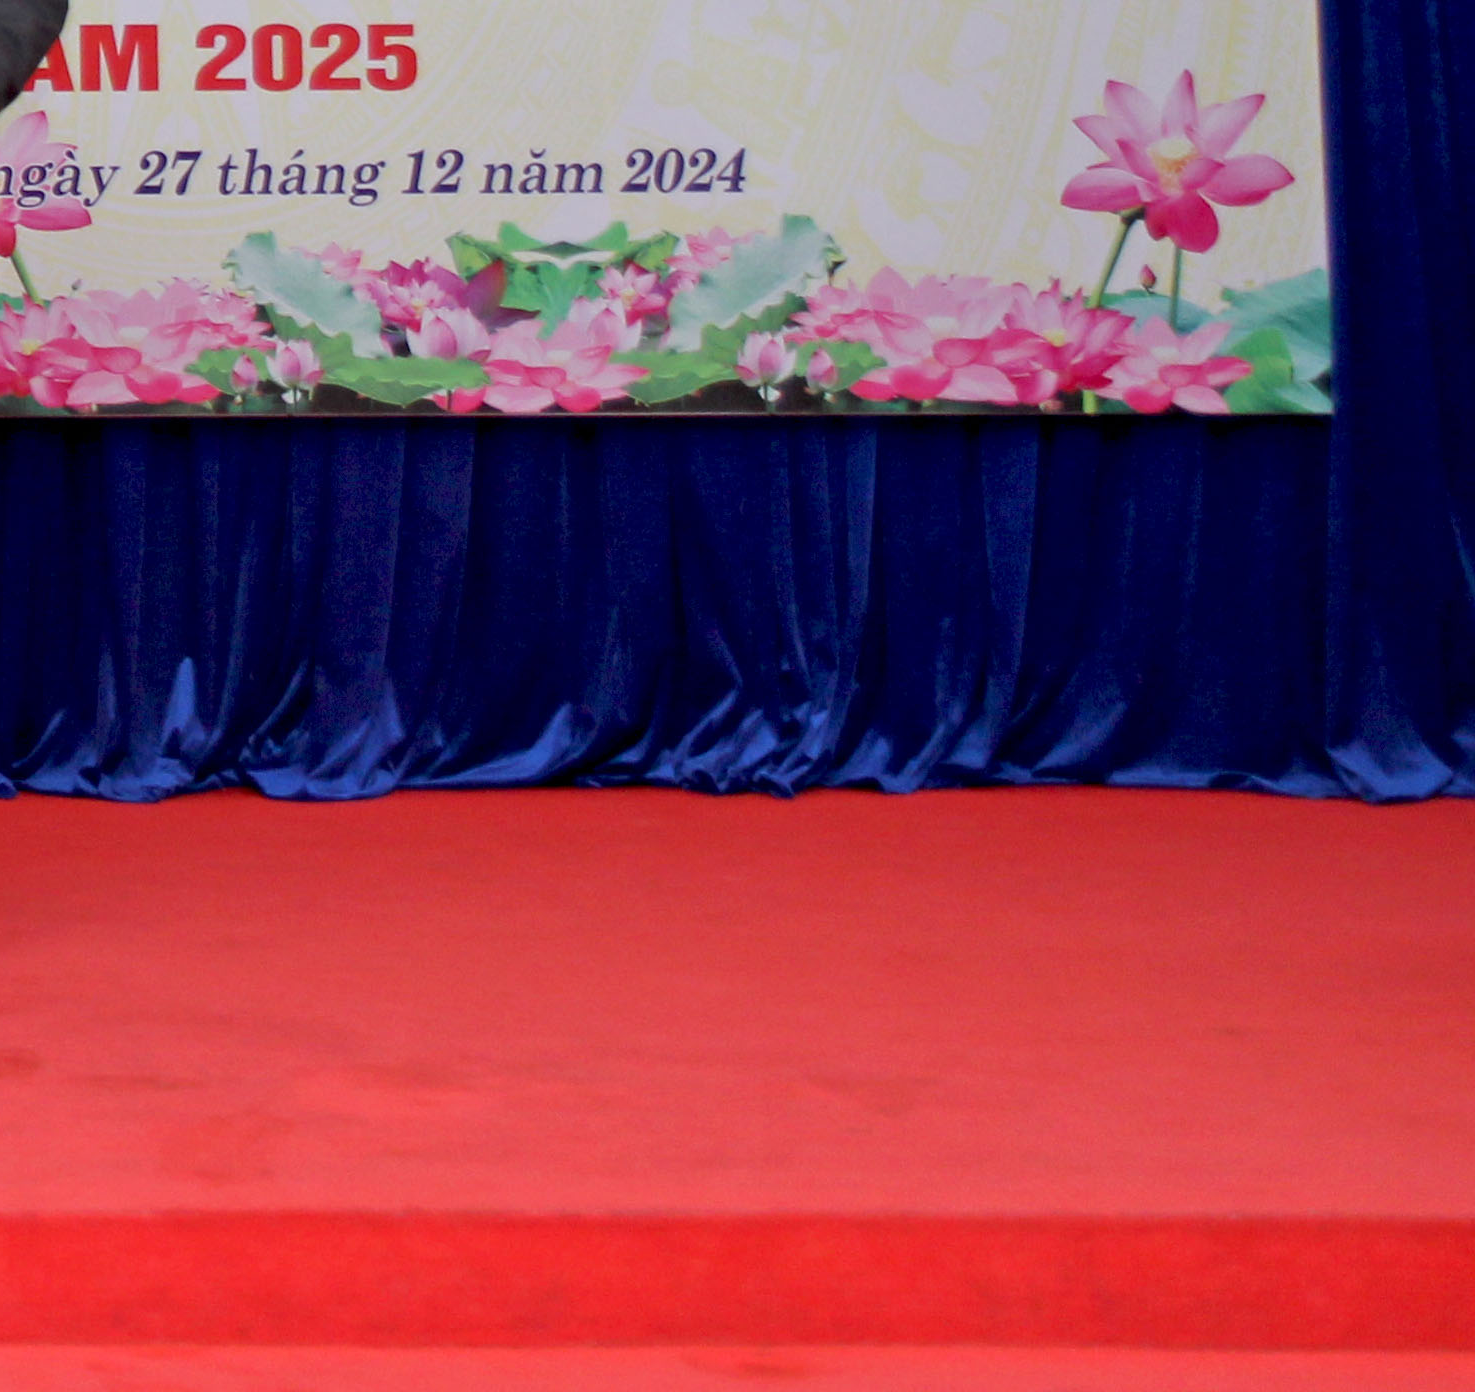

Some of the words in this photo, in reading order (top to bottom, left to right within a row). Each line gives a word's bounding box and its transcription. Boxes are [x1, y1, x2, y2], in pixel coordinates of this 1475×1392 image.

[194, 23, 419, 92] 2025
[133, 149, 203, 197] 27
[217, 147, 387, 207] tháng
[401, 148, 465, 196] 12
[480, 149, 604, 196] năm
[619, 147, 748, 196] 2024
